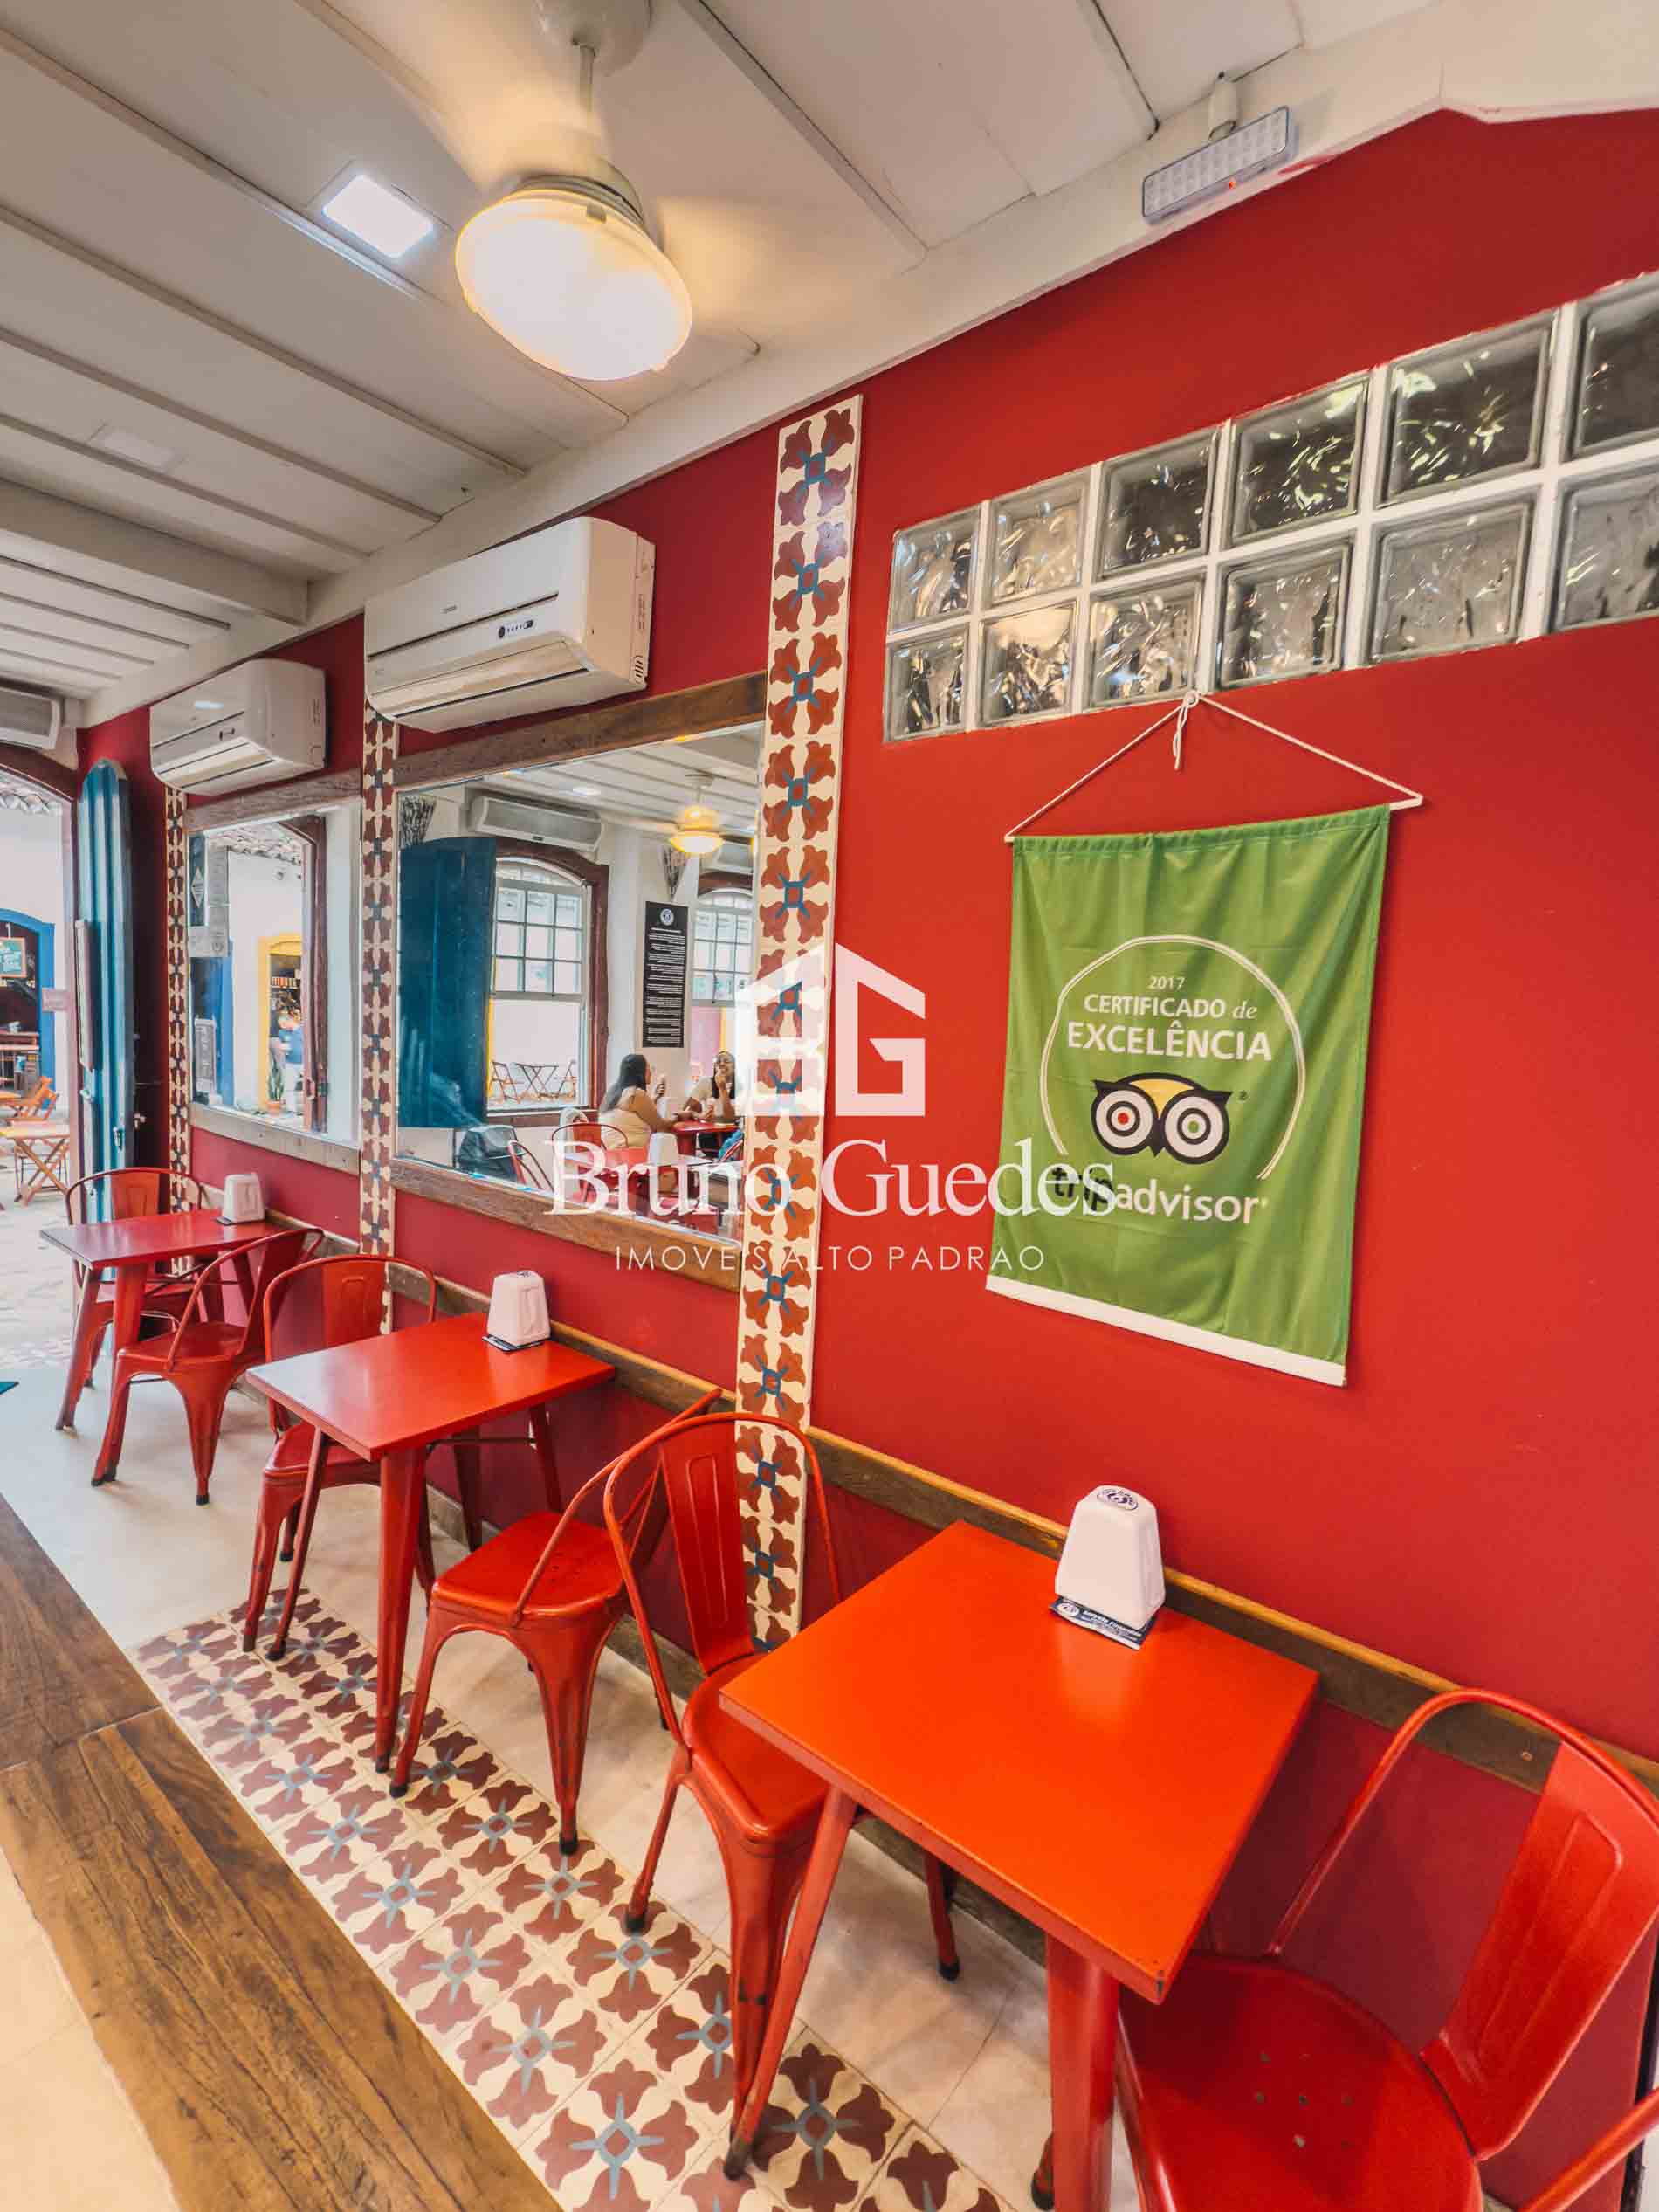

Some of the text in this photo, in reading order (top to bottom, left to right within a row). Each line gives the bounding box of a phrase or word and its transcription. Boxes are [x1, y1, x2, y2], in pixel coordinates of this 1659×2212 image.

[1148, 975, 1186, 990] 2017
[1083, 993, 1258, 1020] CERTIFICADO de
[1067, 1019, 1272, 1062] EXCELÊNCIA
